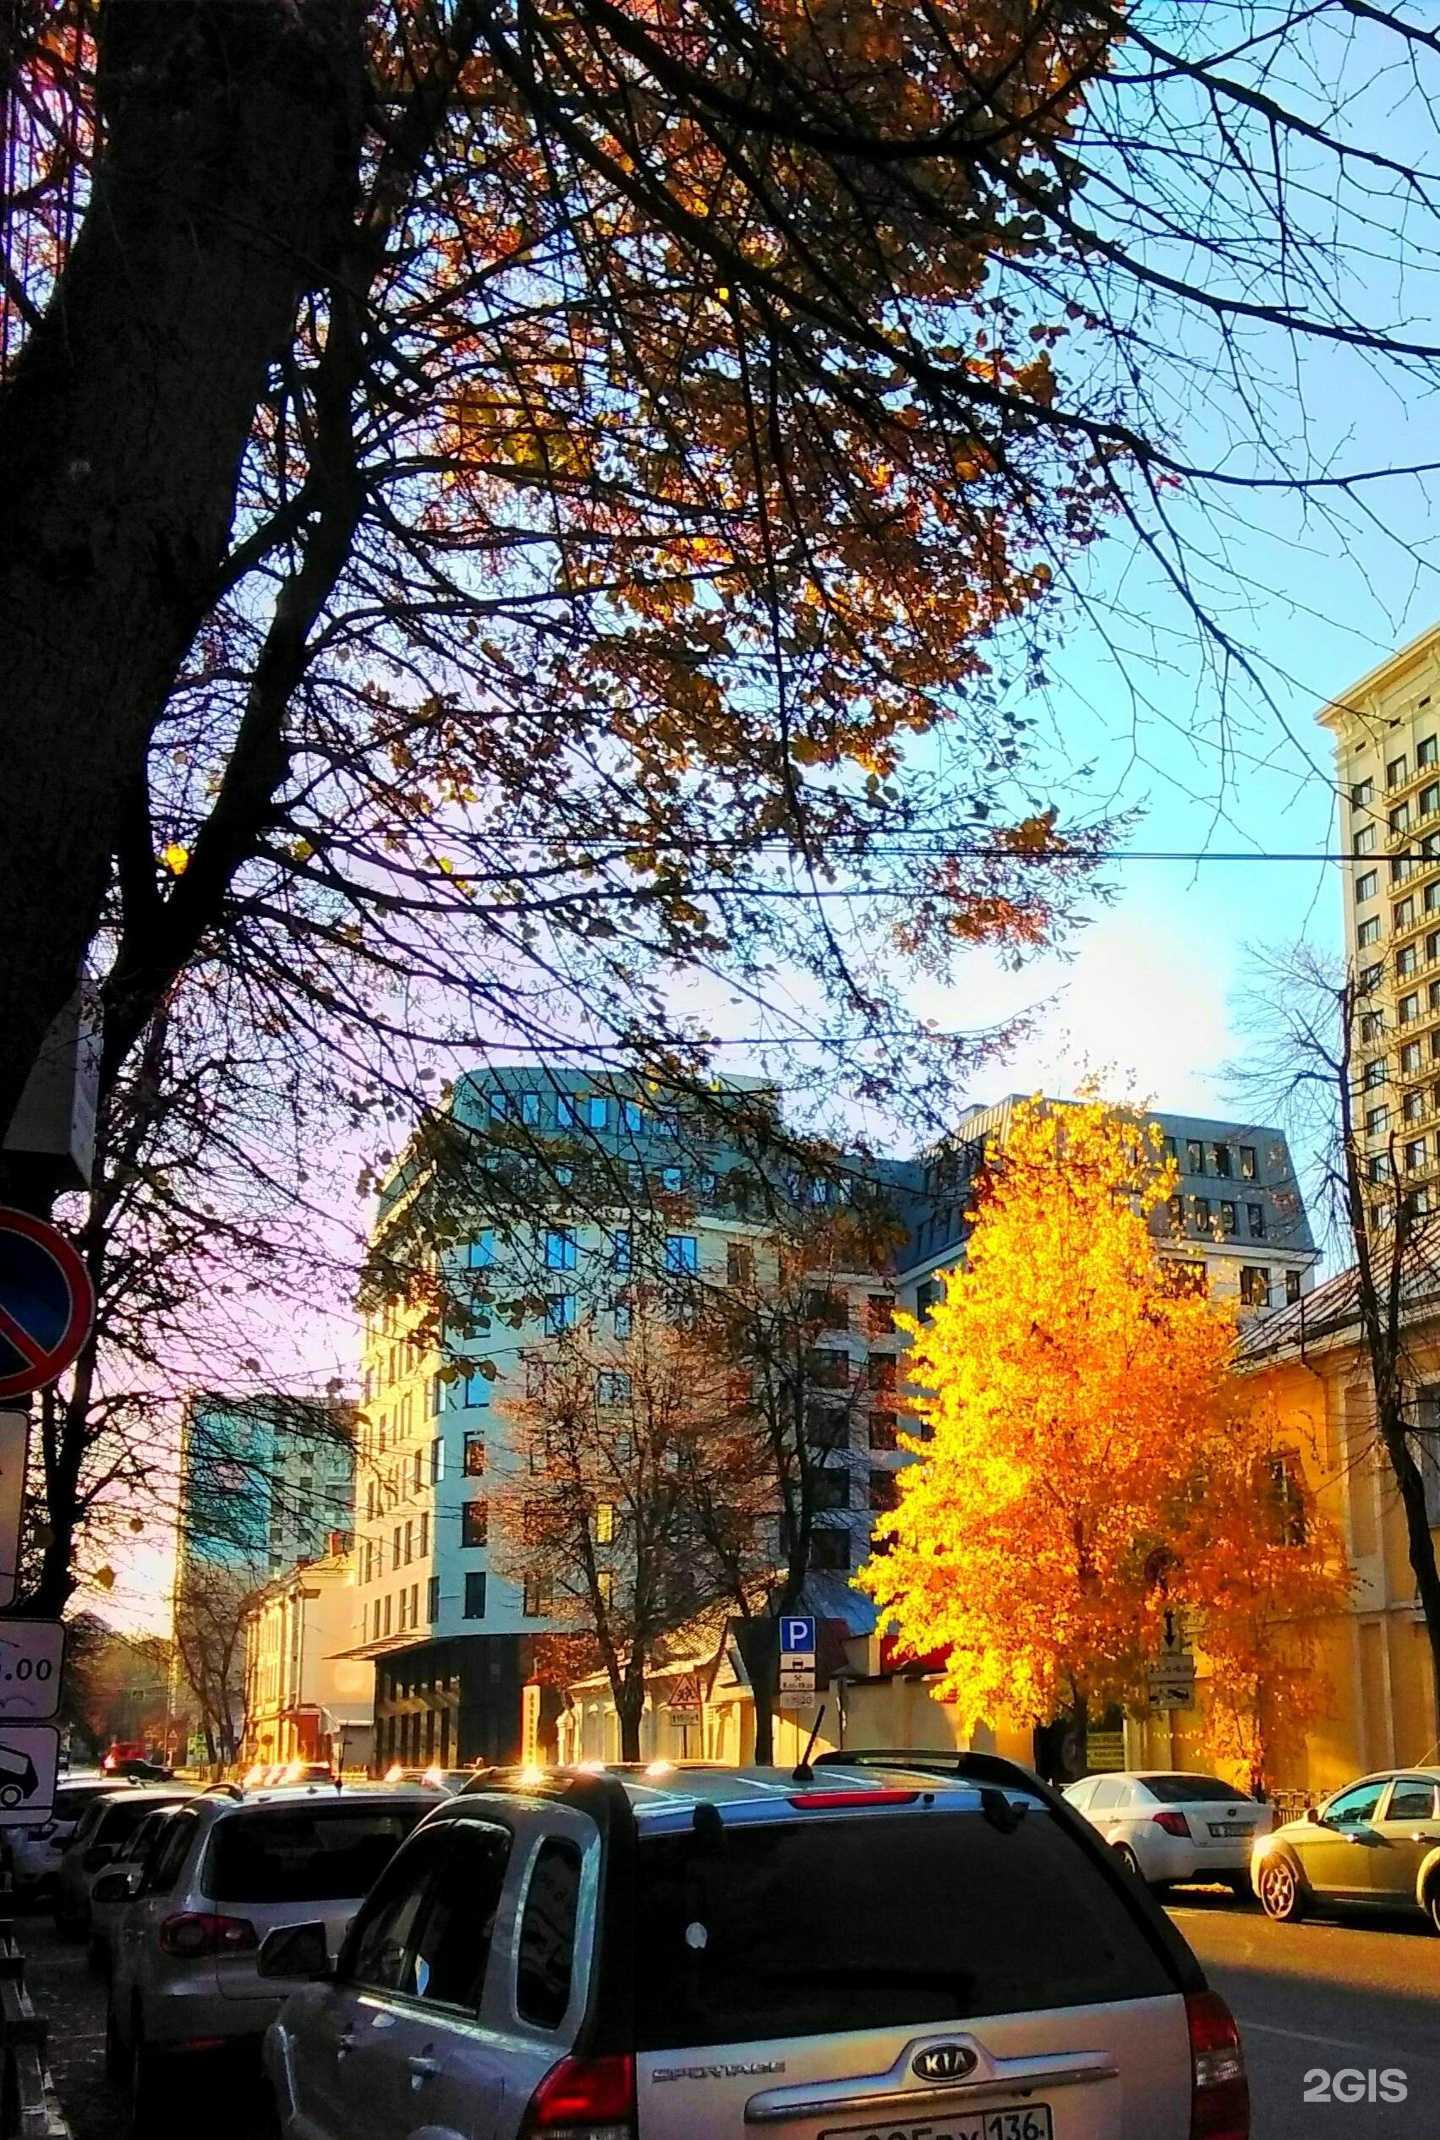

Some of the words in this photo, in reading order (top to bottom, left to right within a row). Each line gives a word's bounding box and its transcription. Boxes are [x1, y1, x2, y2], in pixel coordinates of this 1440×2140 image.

[790, 1621, 808, 1649] P
[0, 1658, 52, 1681] .00
[924, 2051, 968, 2073] KIA
[989, 2112, 1039, 2140] 136
